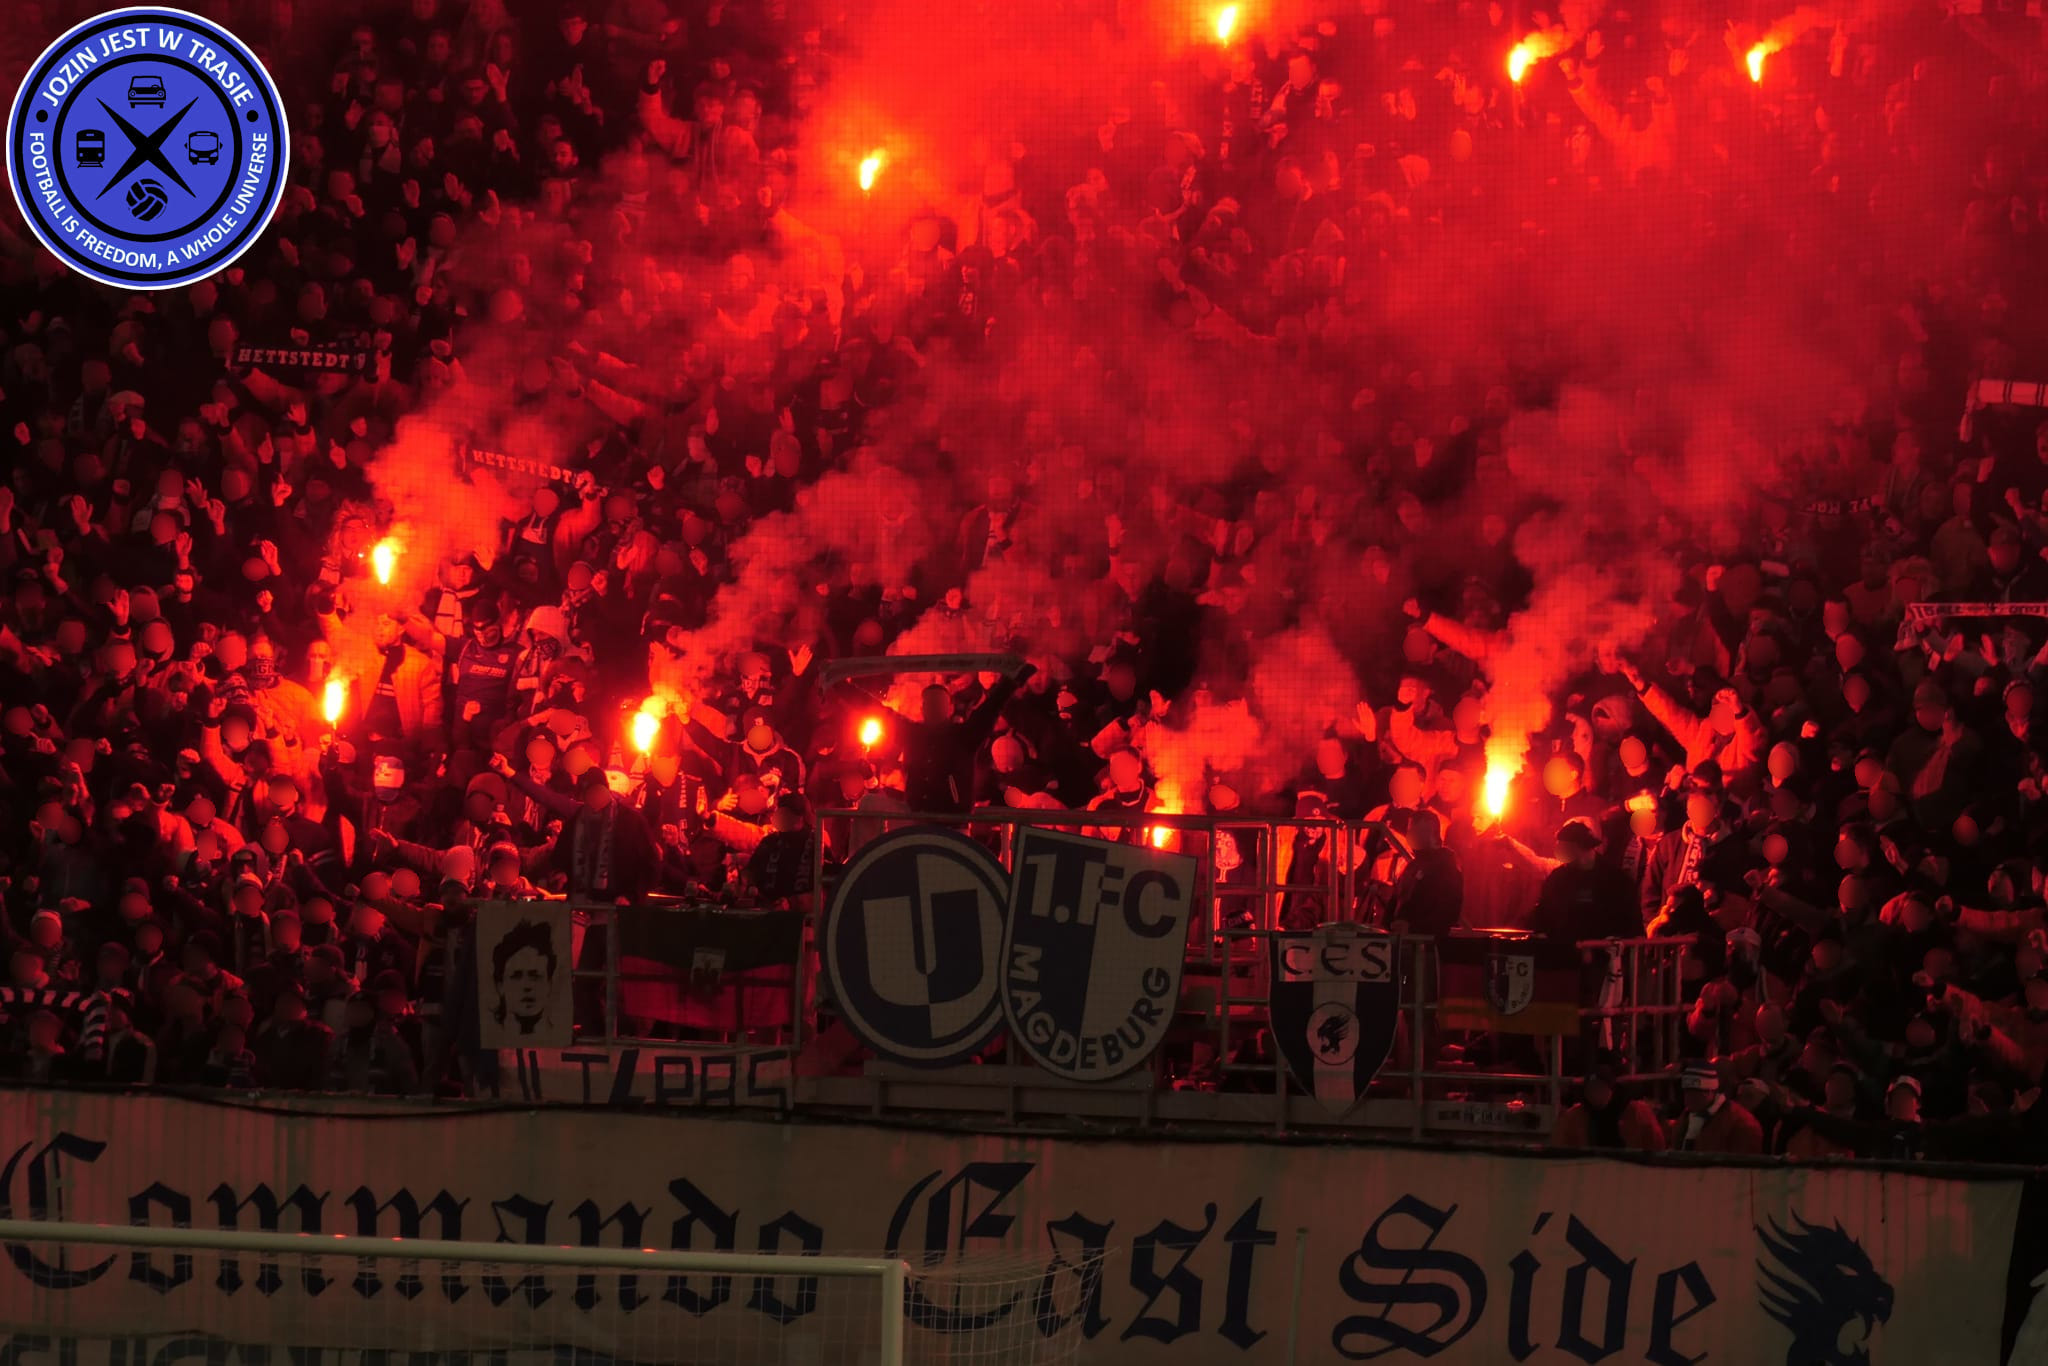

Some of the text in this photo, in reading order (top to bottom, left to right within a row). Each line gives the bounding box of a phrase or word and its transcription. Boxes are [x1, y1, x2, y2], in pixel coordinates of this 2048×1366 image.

[238, 348, 350, 368] HETTSTEDT
[472, 449, 572, 484] HETTSTEDT
[1008, 943, 1171, 1069] MAGDEBURG
[0, 1131, 1717, 1366] Commando East Side
